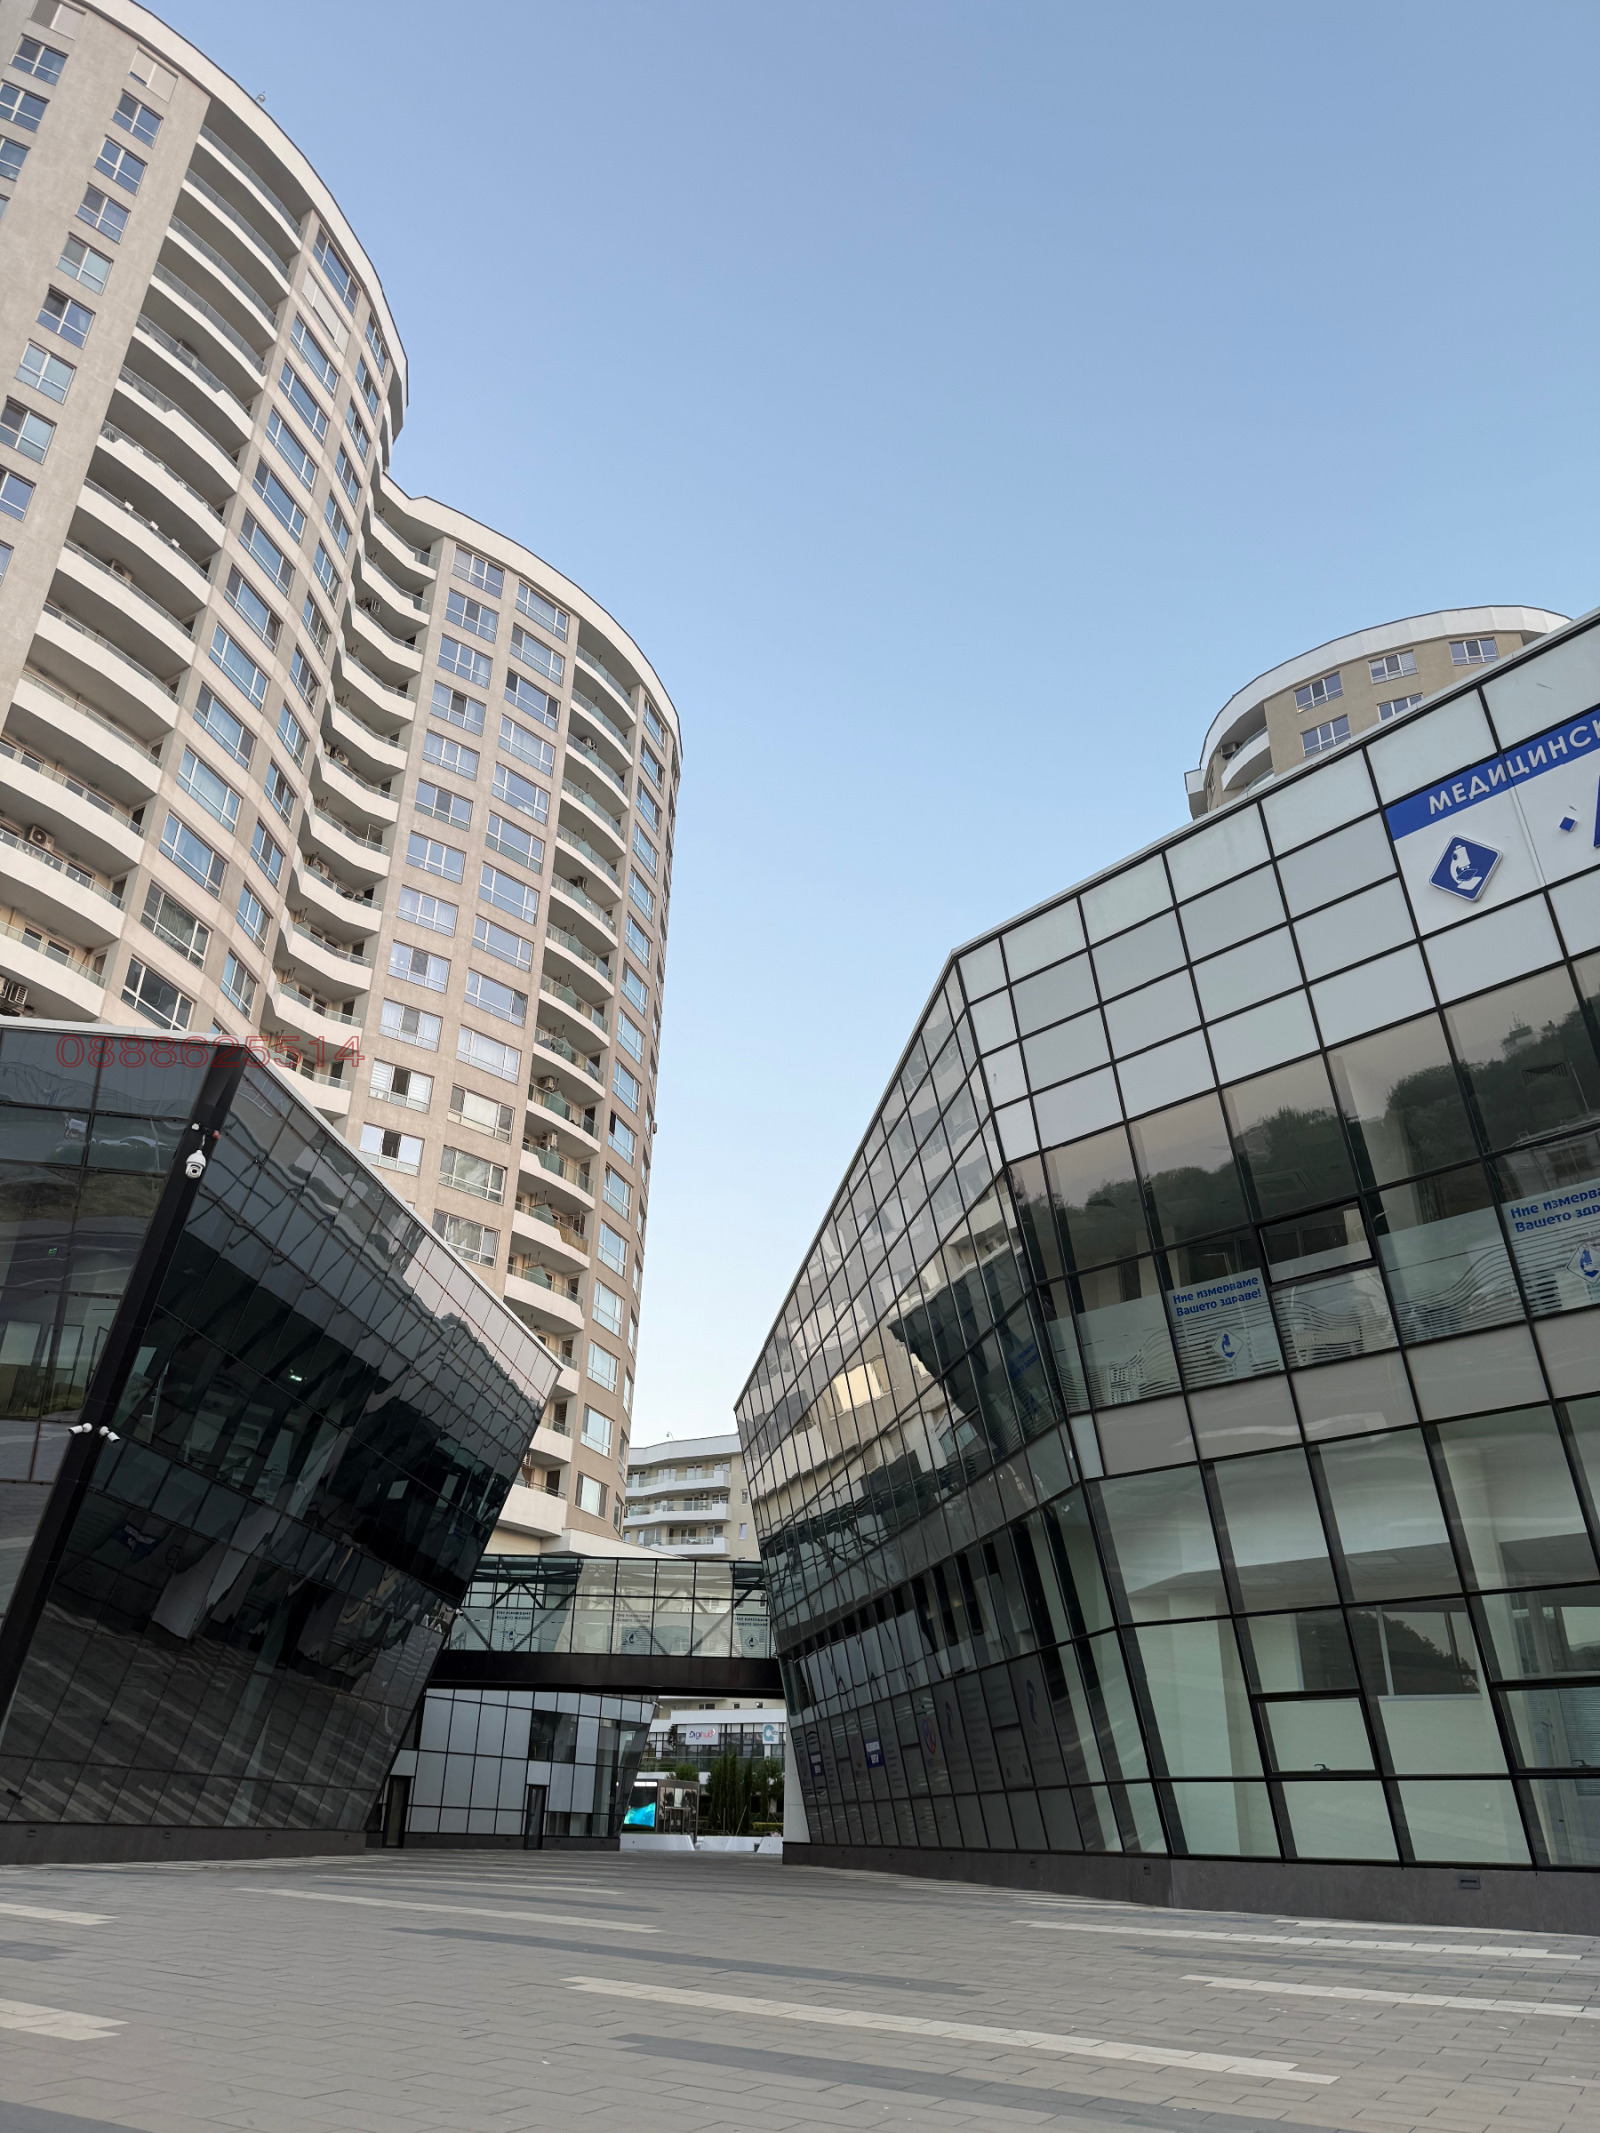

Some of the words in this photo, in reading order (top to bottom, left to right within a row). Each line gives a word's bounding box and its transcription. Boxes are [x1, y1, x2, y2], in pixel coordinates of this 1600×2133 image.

[1510, 1204, 1539, 1219] Ние
[1515, 1212, 1572, 1232] Вашето
[1173, 1293, 1194, 1305] Ние
[1196, 1277, 1259, 1299] измерваме
[1176, 1301, 1218, 1317] Вашето
[1219, 1288, 1262, 1307] здраве!
